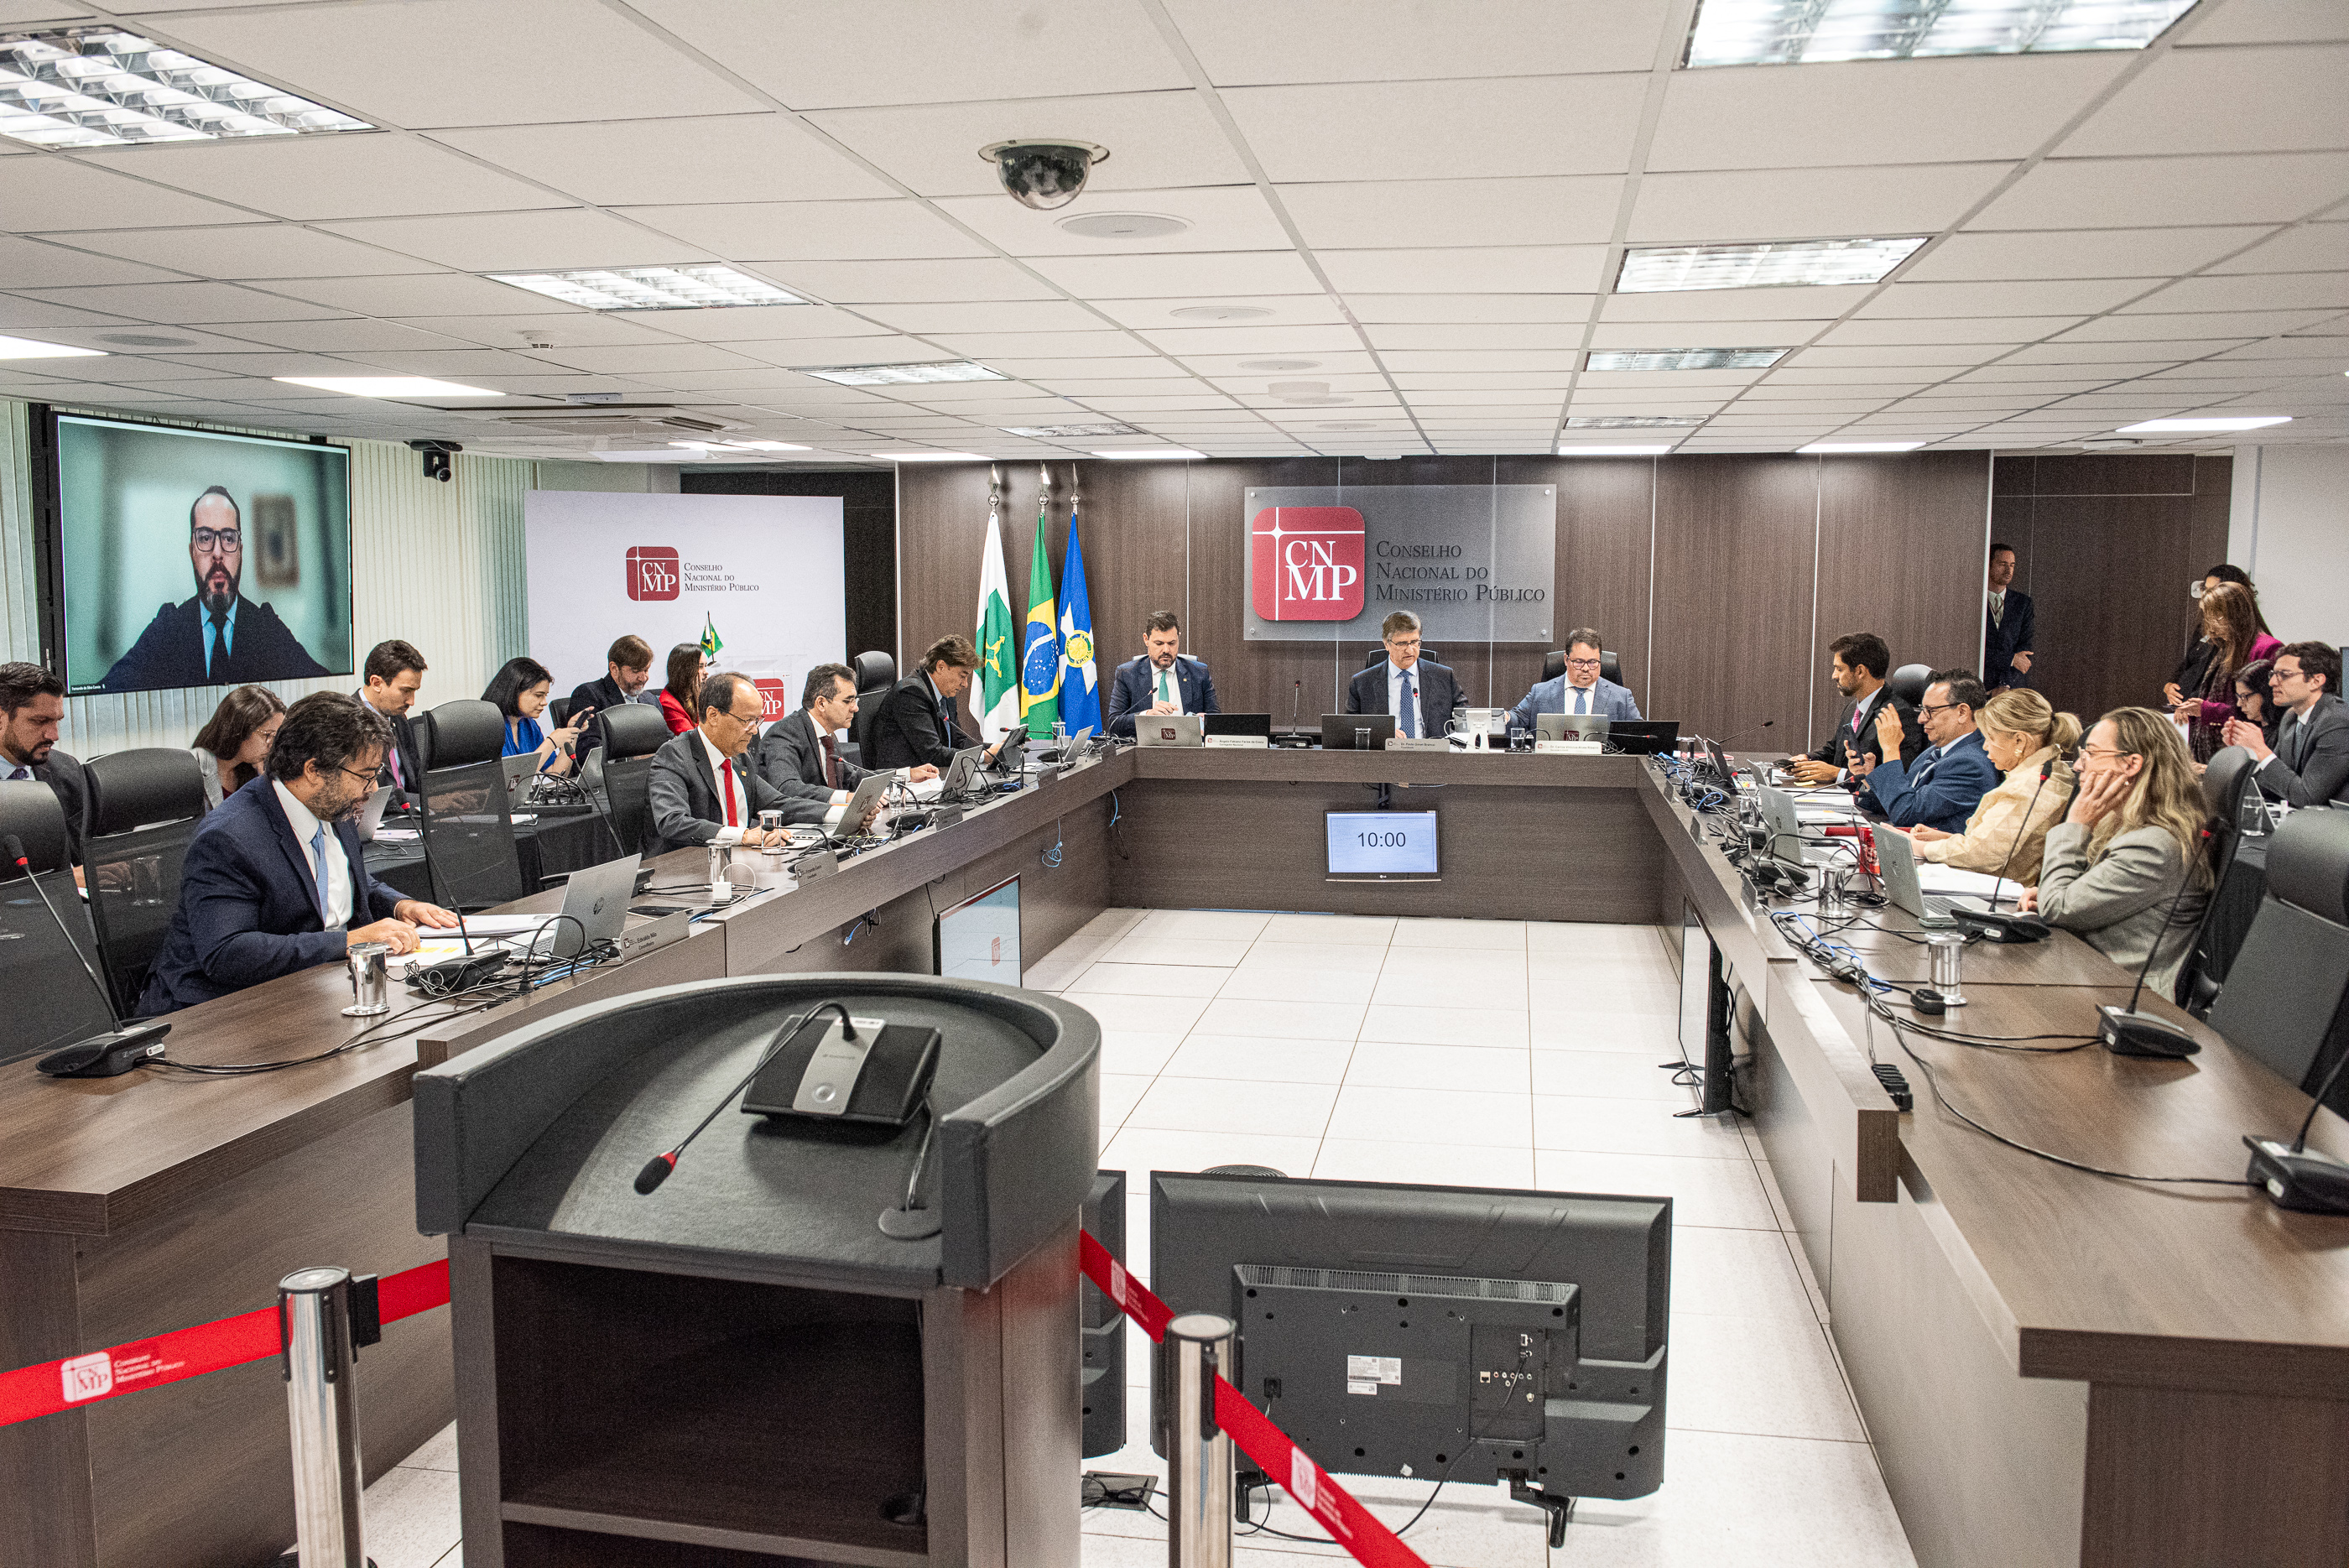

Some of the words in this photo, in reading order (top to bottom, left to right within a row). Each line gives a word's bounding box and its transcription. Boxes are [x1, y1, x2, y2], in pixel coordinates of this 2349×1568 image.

[1285, 540, 1336, 568] CN
[642, 562, 665, 576] CN
[643, 574, 676, 591] MP
[1284, 565, 1357, 601] MP
[1358, 832, 1406, 847] 10:00
